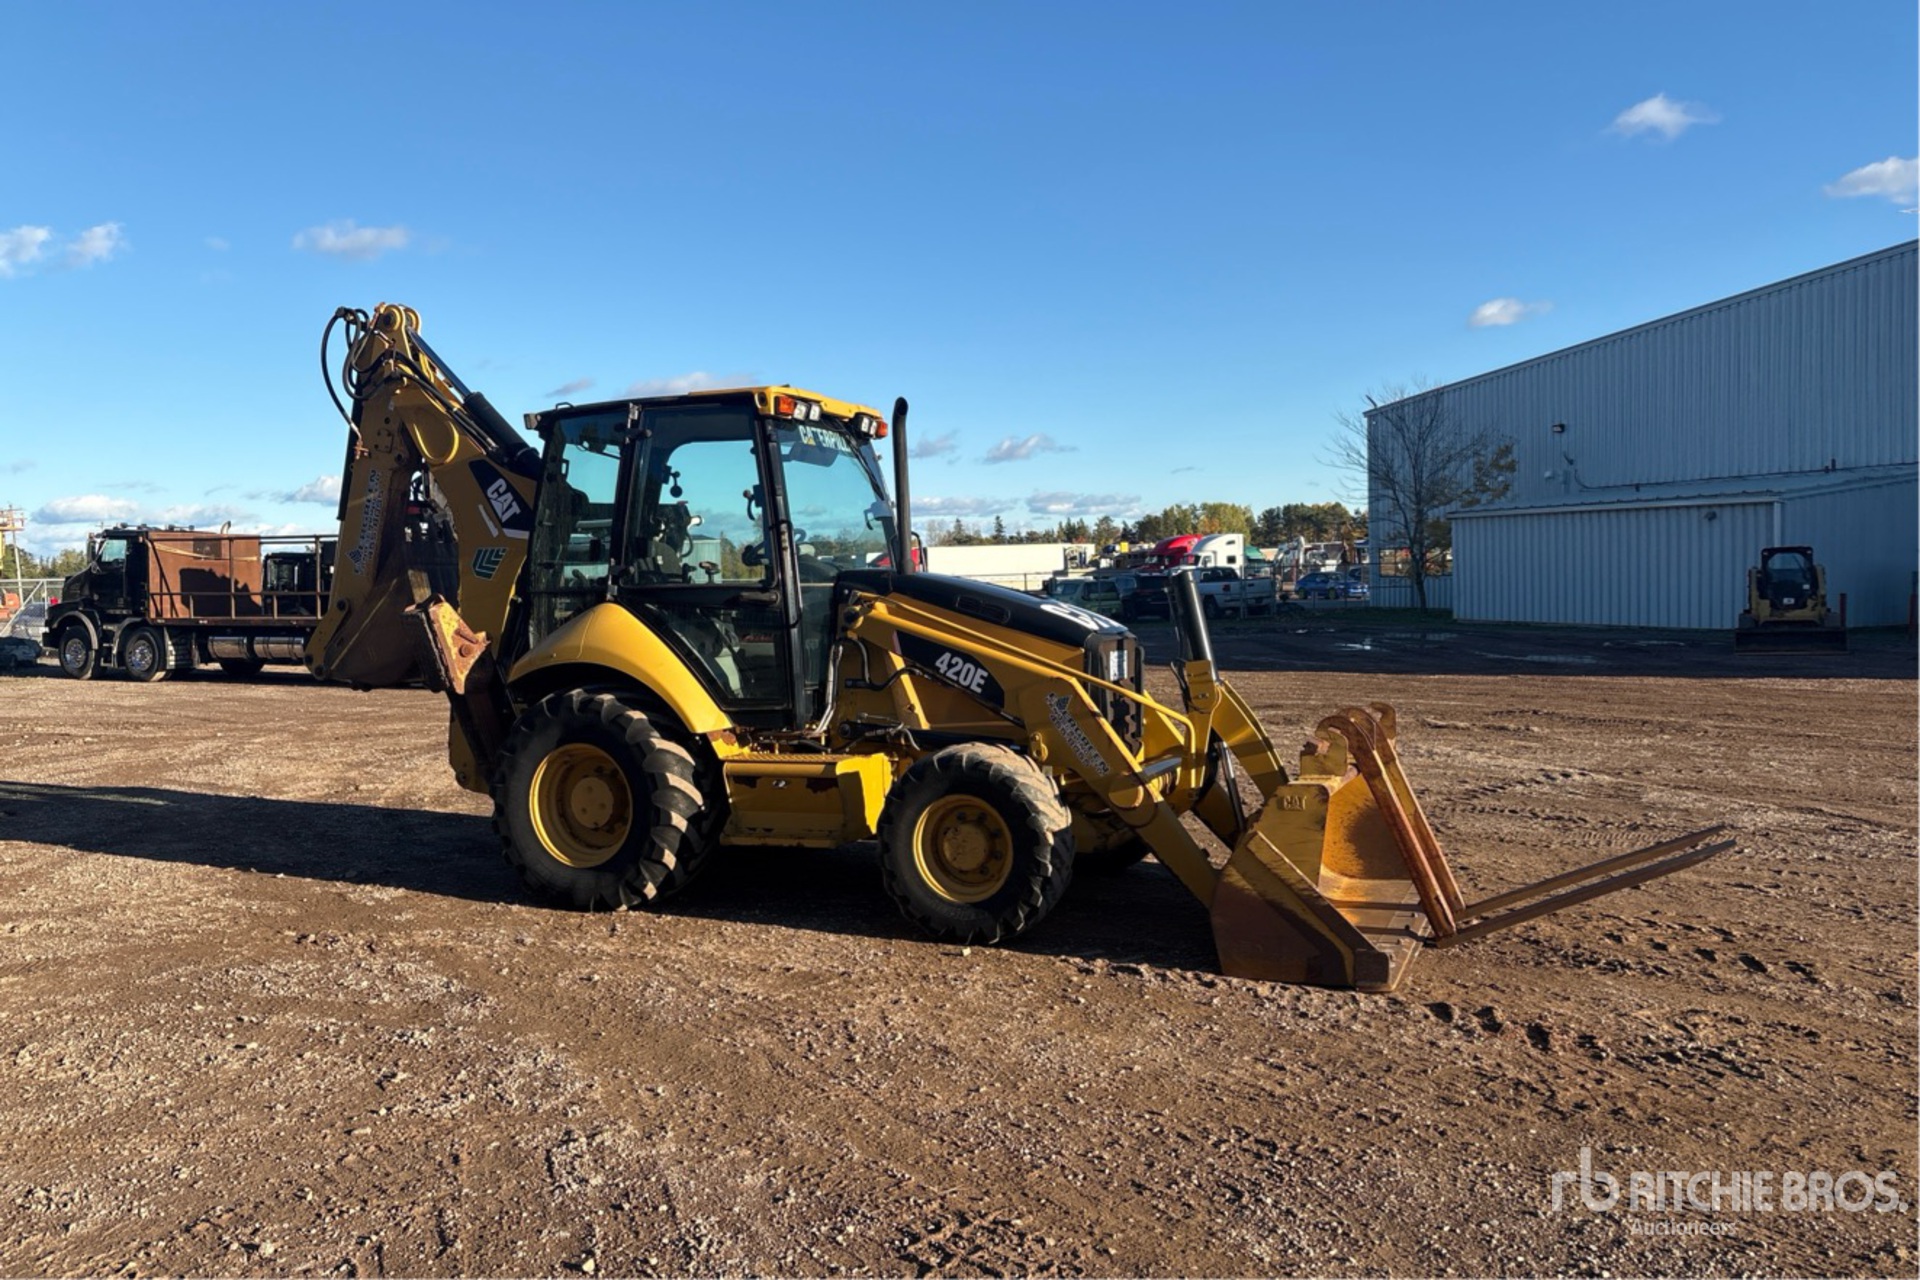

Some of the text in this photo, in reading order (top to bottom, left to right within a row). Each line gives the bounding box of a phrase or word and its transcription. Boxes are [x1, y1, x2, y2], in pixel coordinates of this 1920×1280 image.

[799, 425, 852, 452] CATERPILL
[486, 478, 521, 523] CAT
[935, 651, 989, 694] 420E
